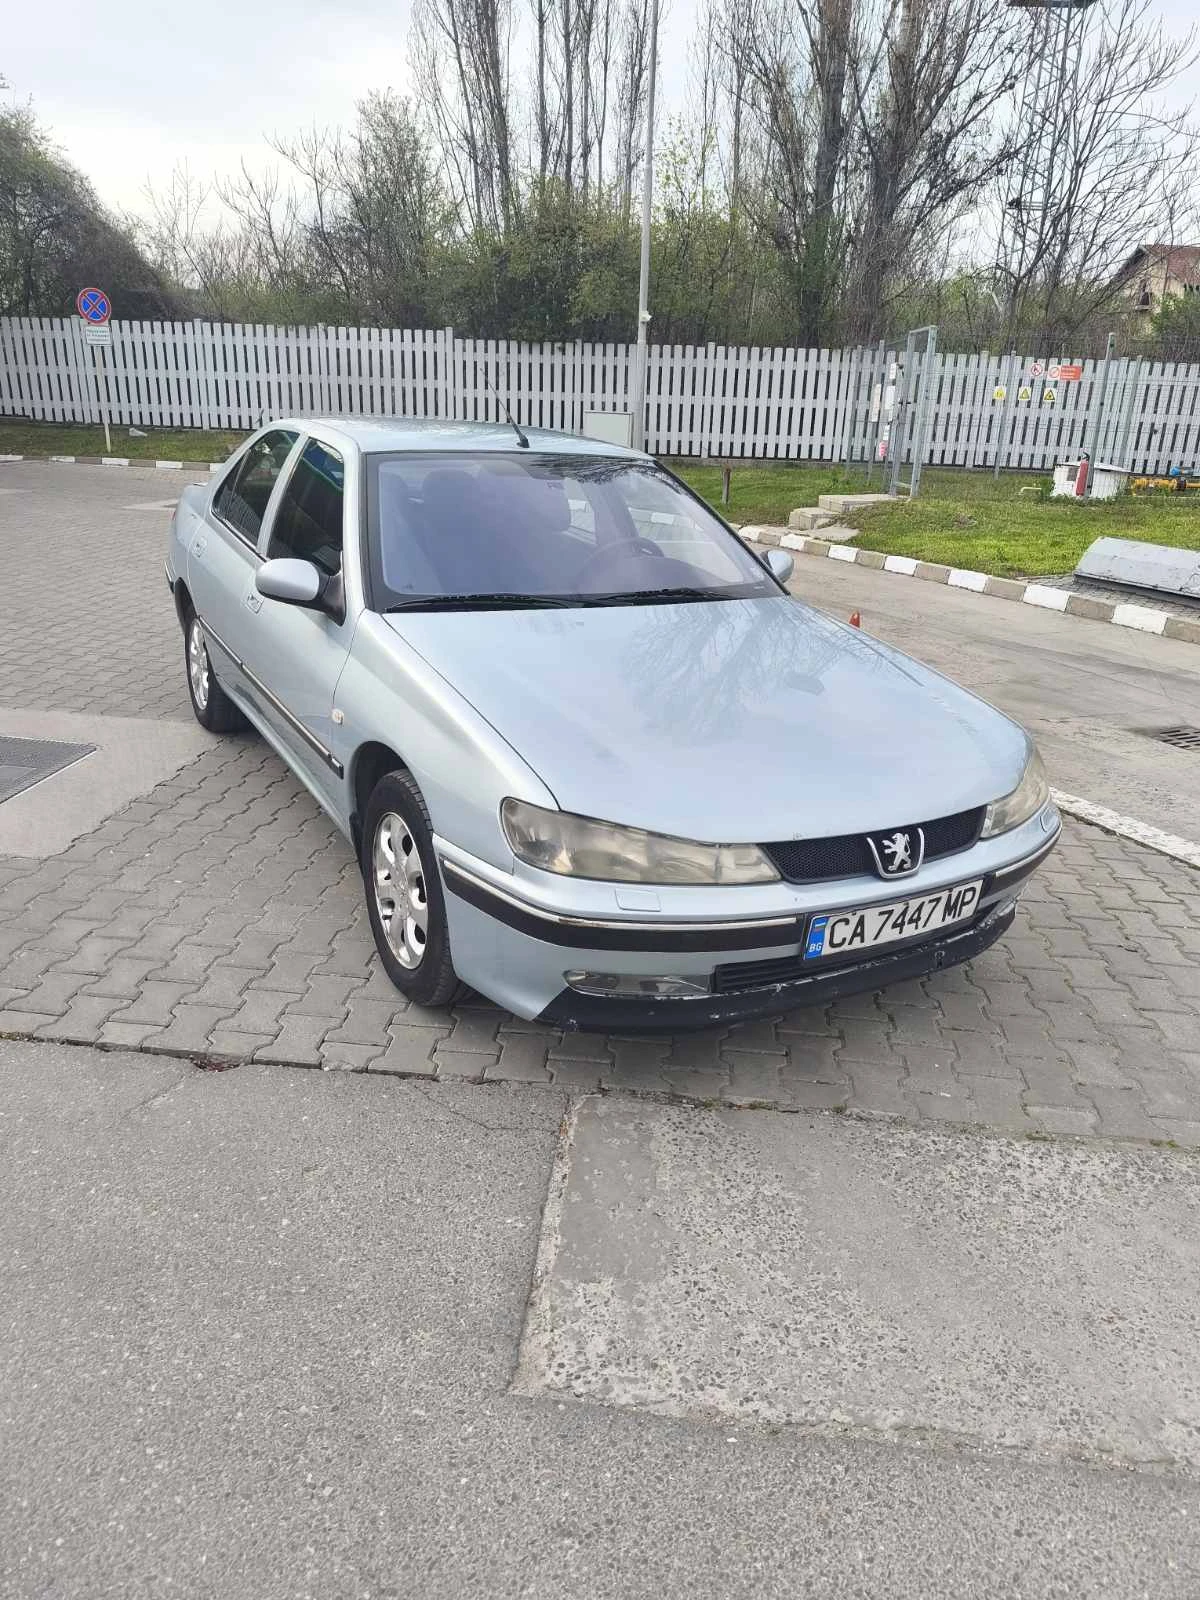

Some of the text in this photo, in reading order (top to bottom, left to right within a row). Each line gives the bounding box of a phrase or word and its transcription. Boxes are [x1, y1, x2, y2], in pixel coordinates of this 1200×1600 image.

[828, 886, 977, 949] CA 7447 MP
[809, 943, 822, 952] BG
